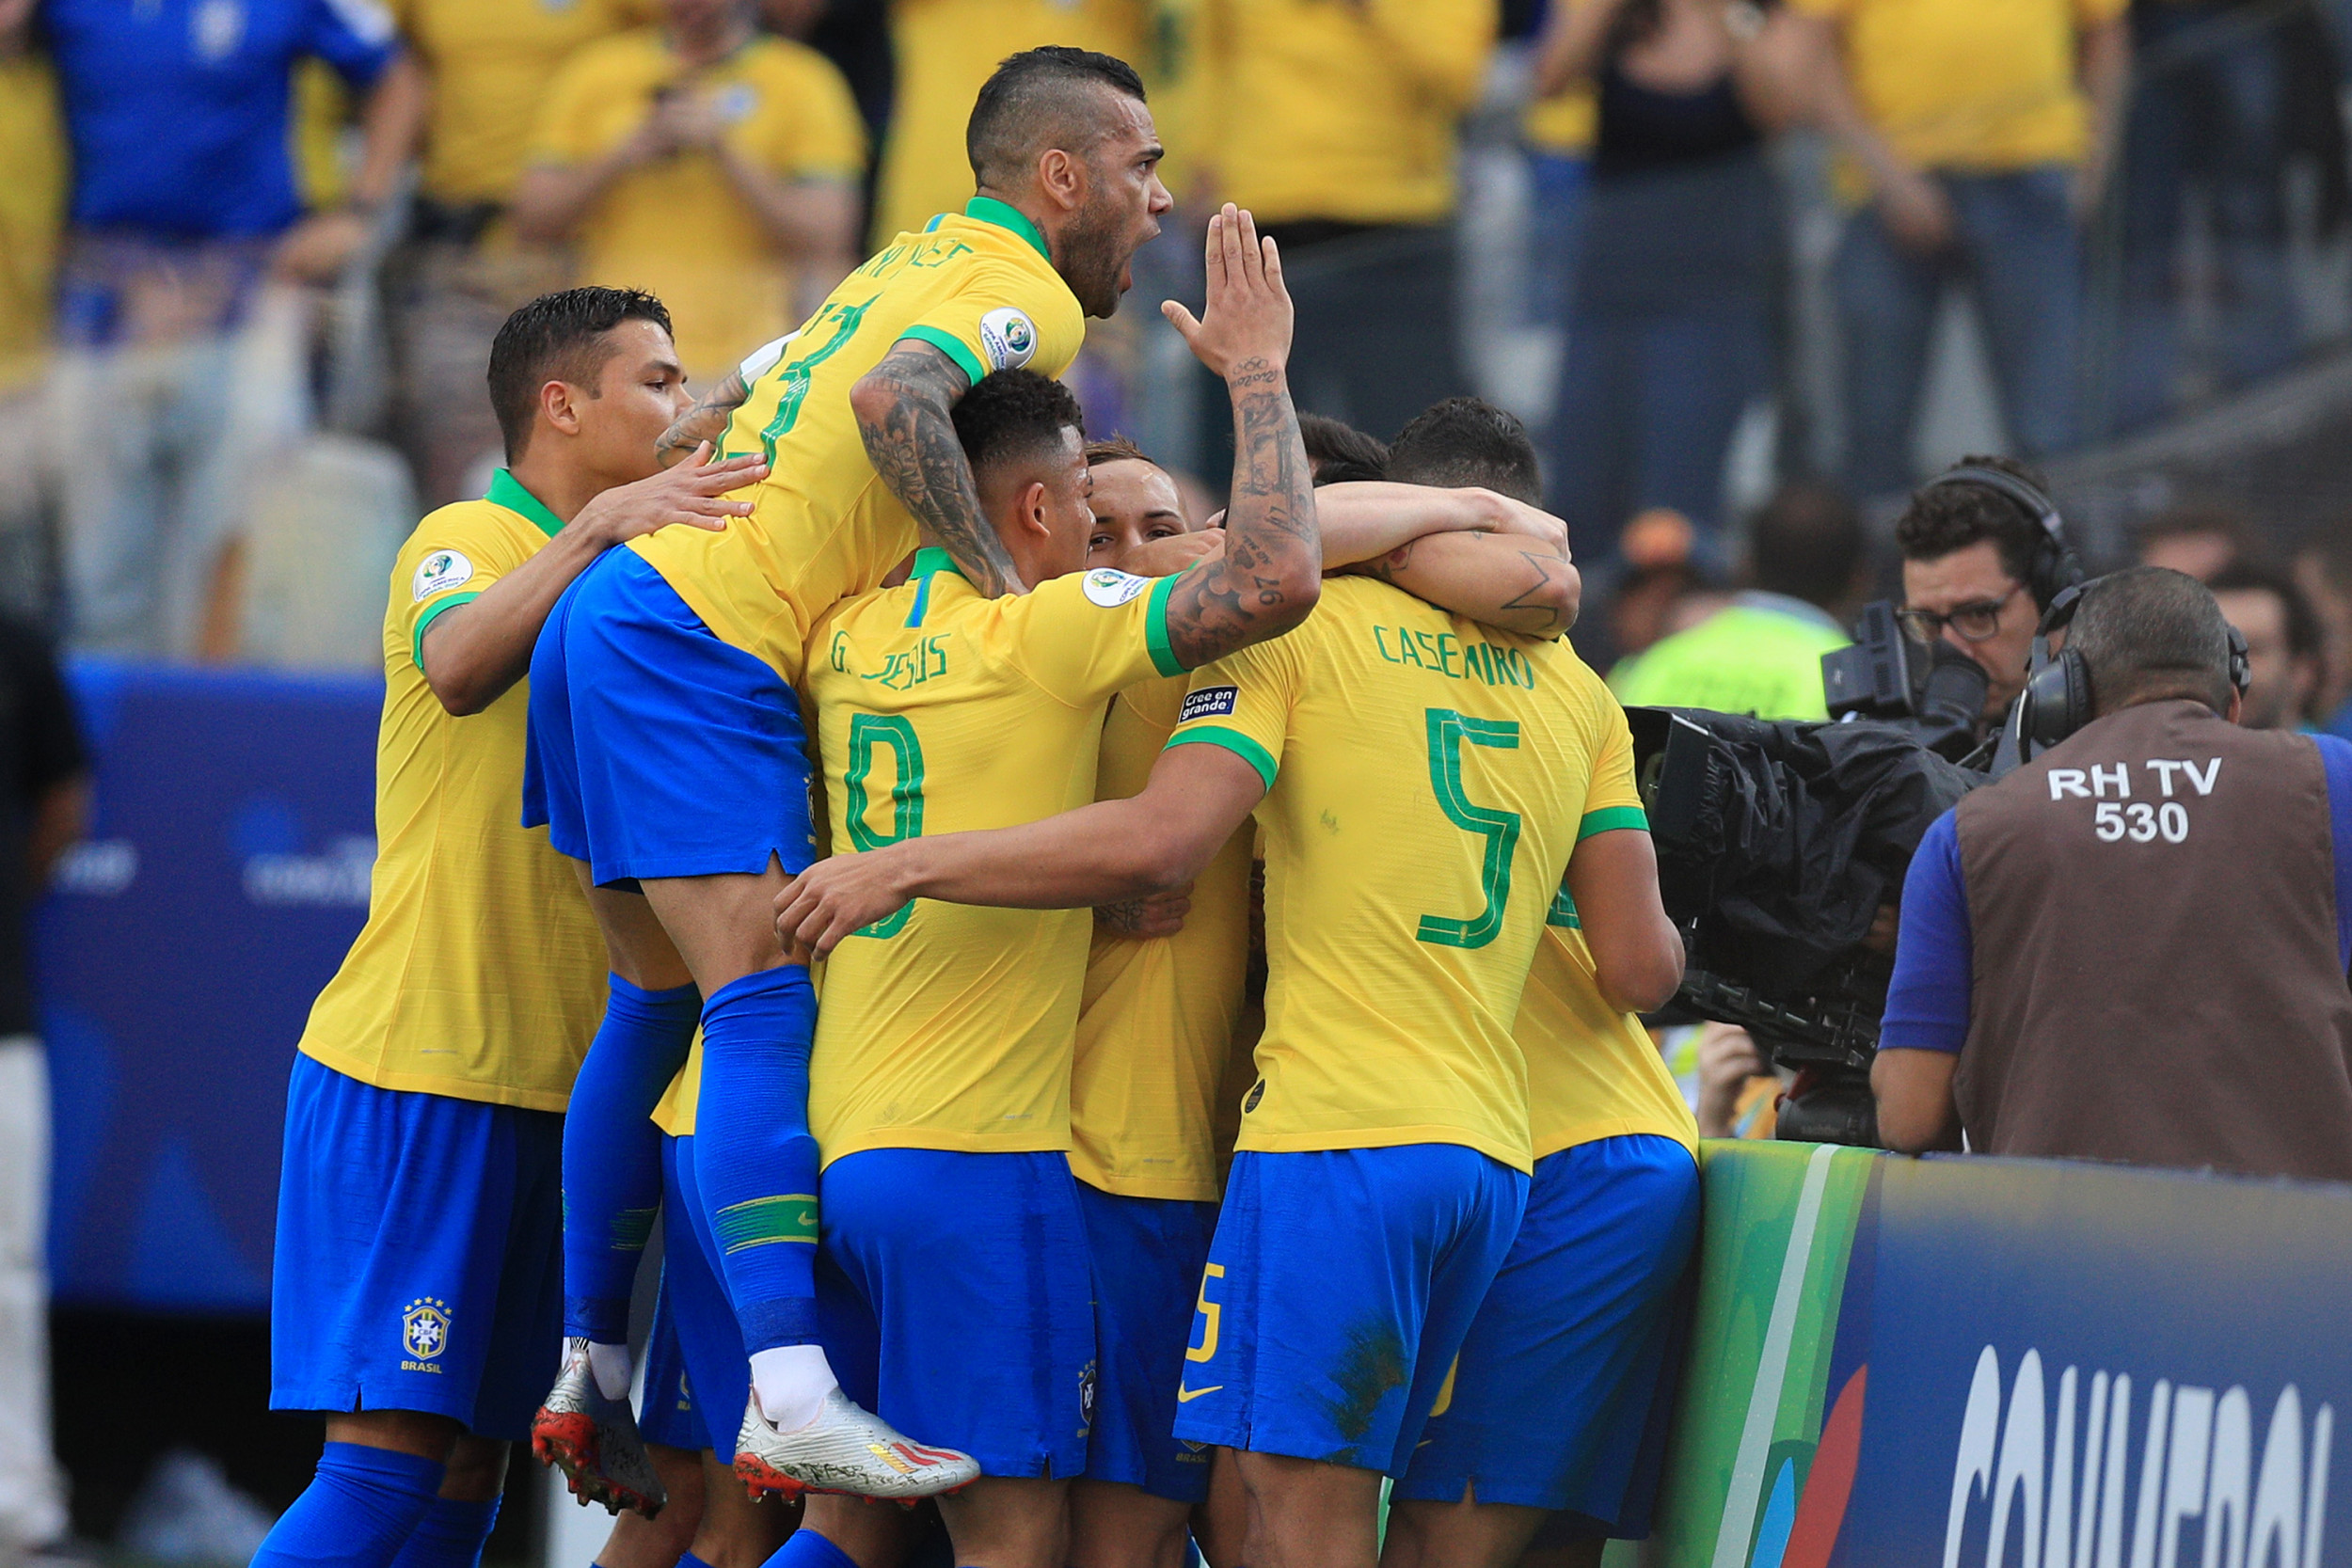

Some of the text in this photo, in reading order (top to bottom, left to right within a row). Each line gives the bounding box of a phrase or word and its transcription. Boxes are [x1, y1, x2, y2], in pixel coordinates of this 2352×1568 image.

[831, 629, 951, 691] G. JESUS
[1185, 690, 1233, 707] Cree en
[2047, 756, 2223, 801] RH TV
[1415, 707, 1521, 950] 5
[2094, 801, 2189, 844] 530
[400, 1360, 443, 1374] BRASIL
